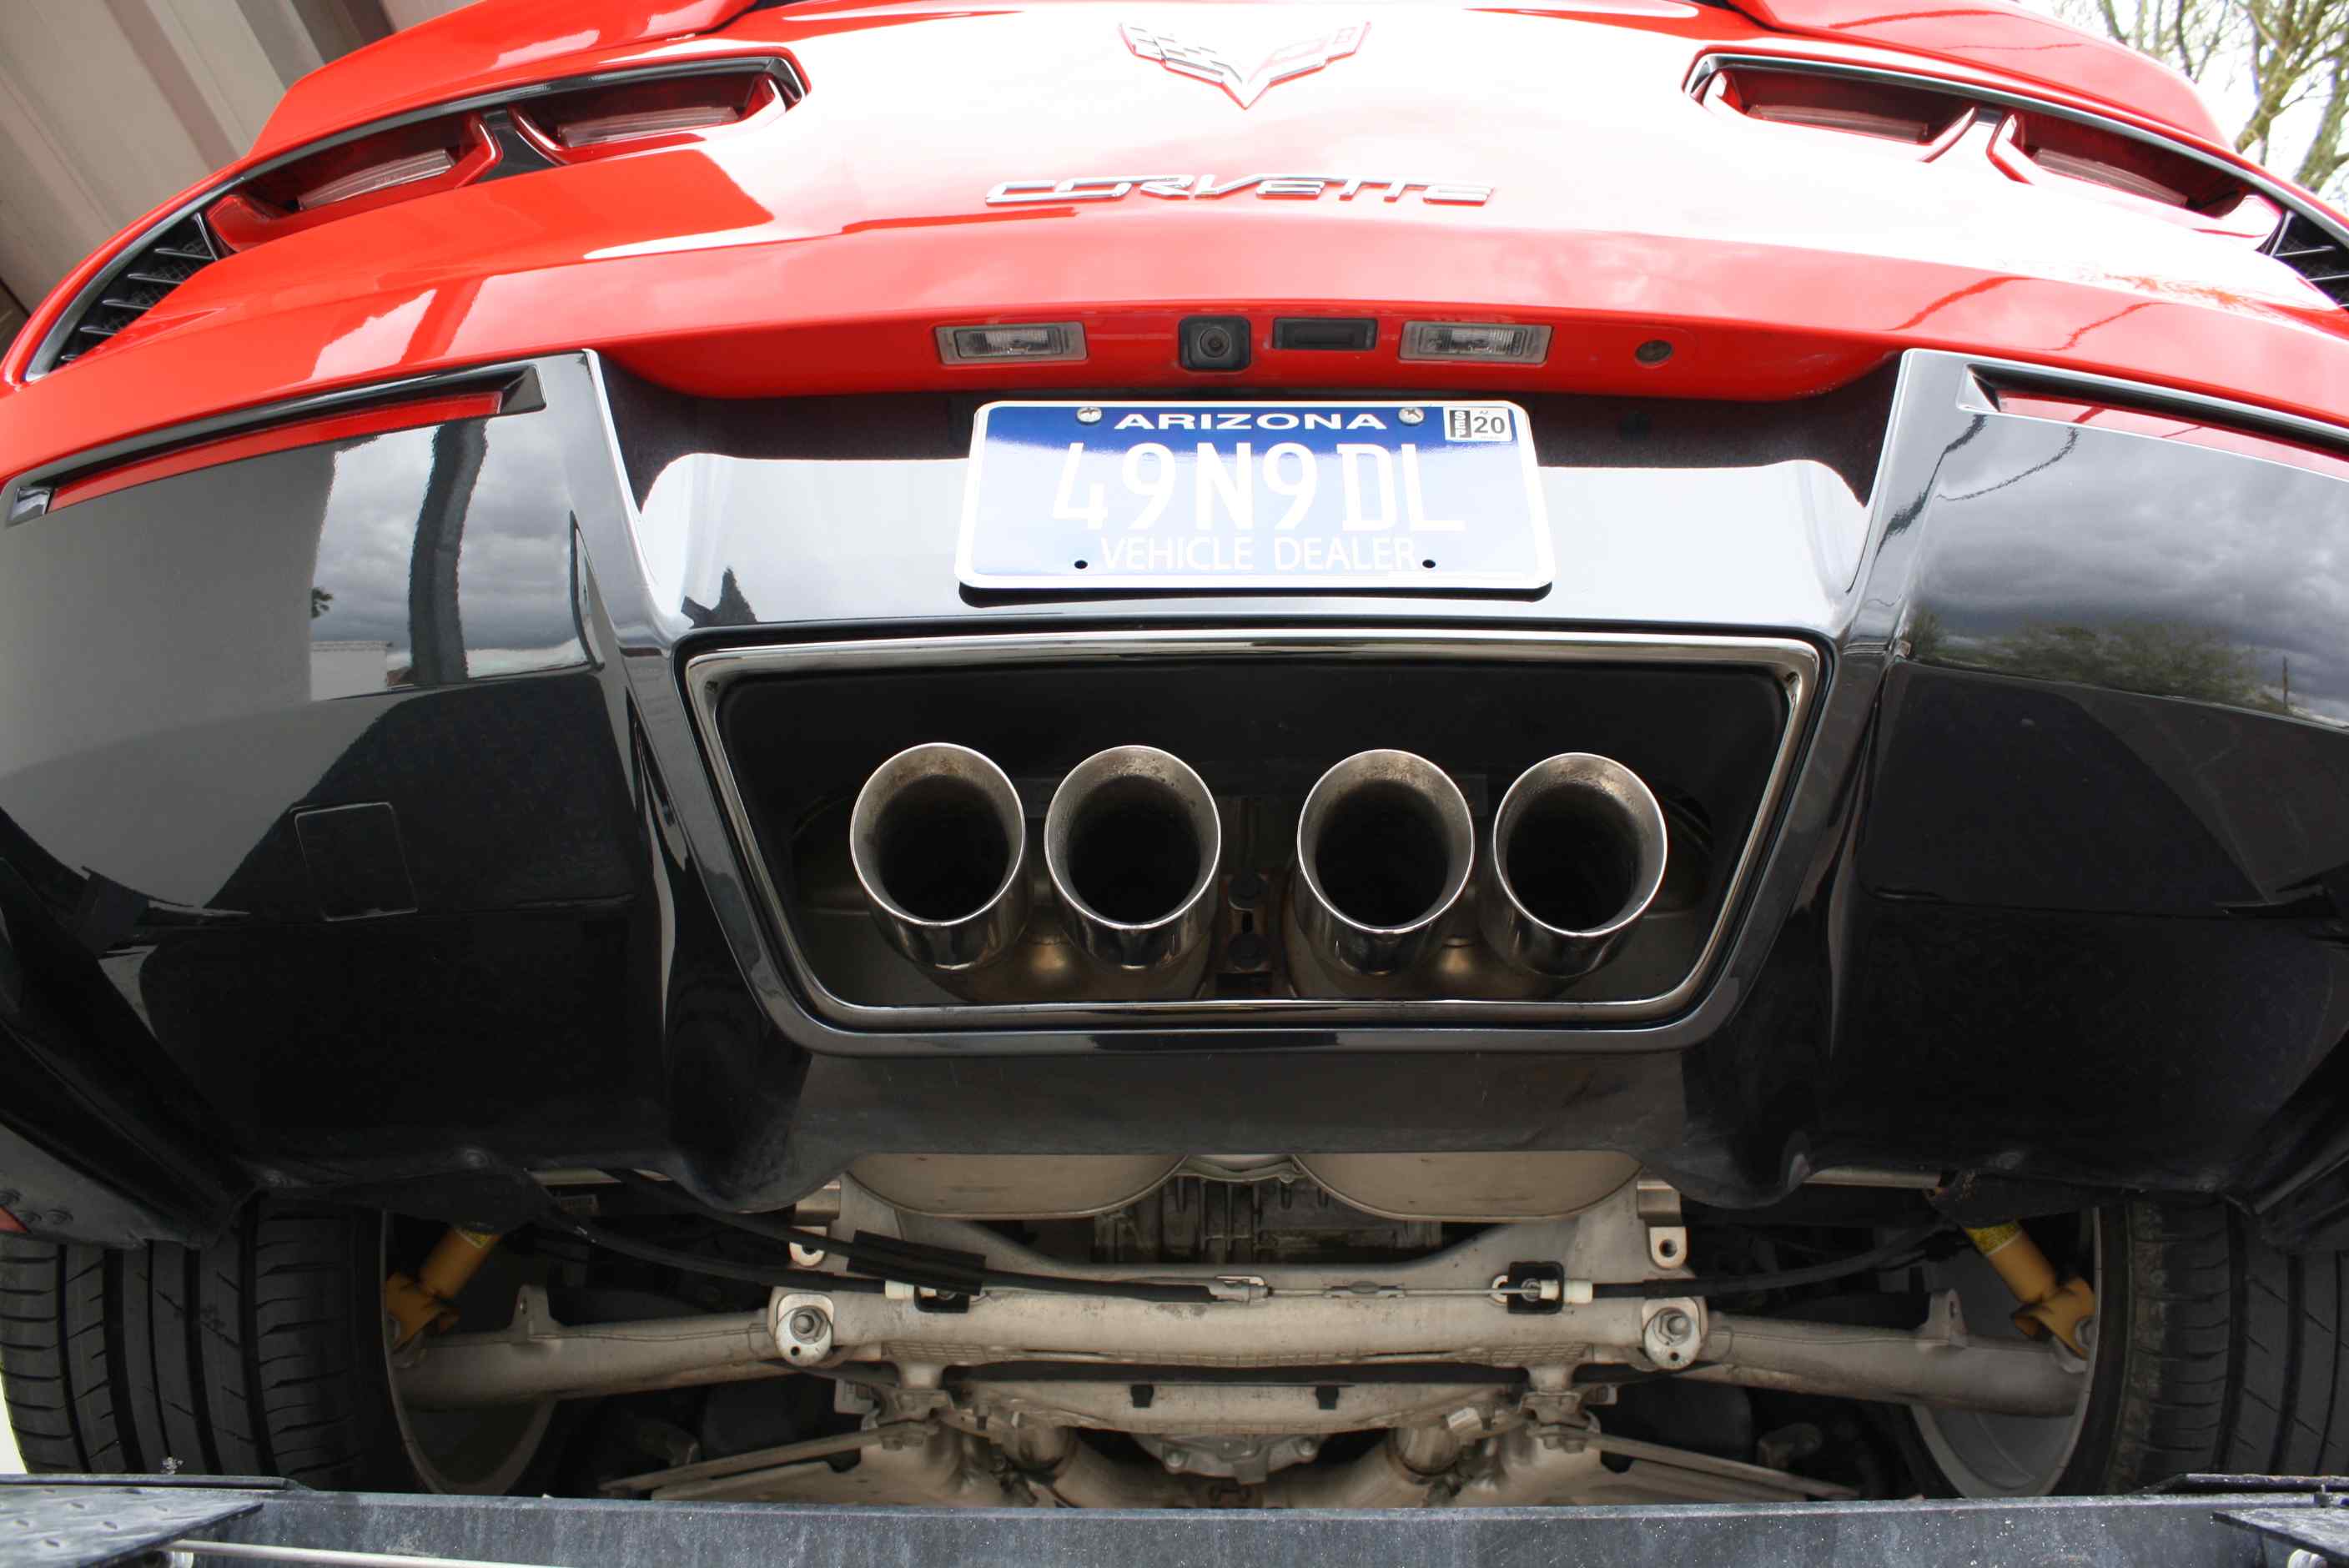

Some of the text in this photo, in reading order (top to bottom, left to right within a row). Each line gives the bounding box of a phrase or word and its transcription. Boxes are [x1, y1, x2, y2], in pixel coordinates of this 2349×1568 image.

[985, 173, 1496, 207] CORVETTE
[1114, 413, 1387, 430] ARIZONA
[1454, 410, 1466, 440] SEP
[1473, 415, 1506, 435] 20
[1052, 442, 1466, 532] 49N9DL
[1101, 536, 1417, 572] VEHICLE DEALER
